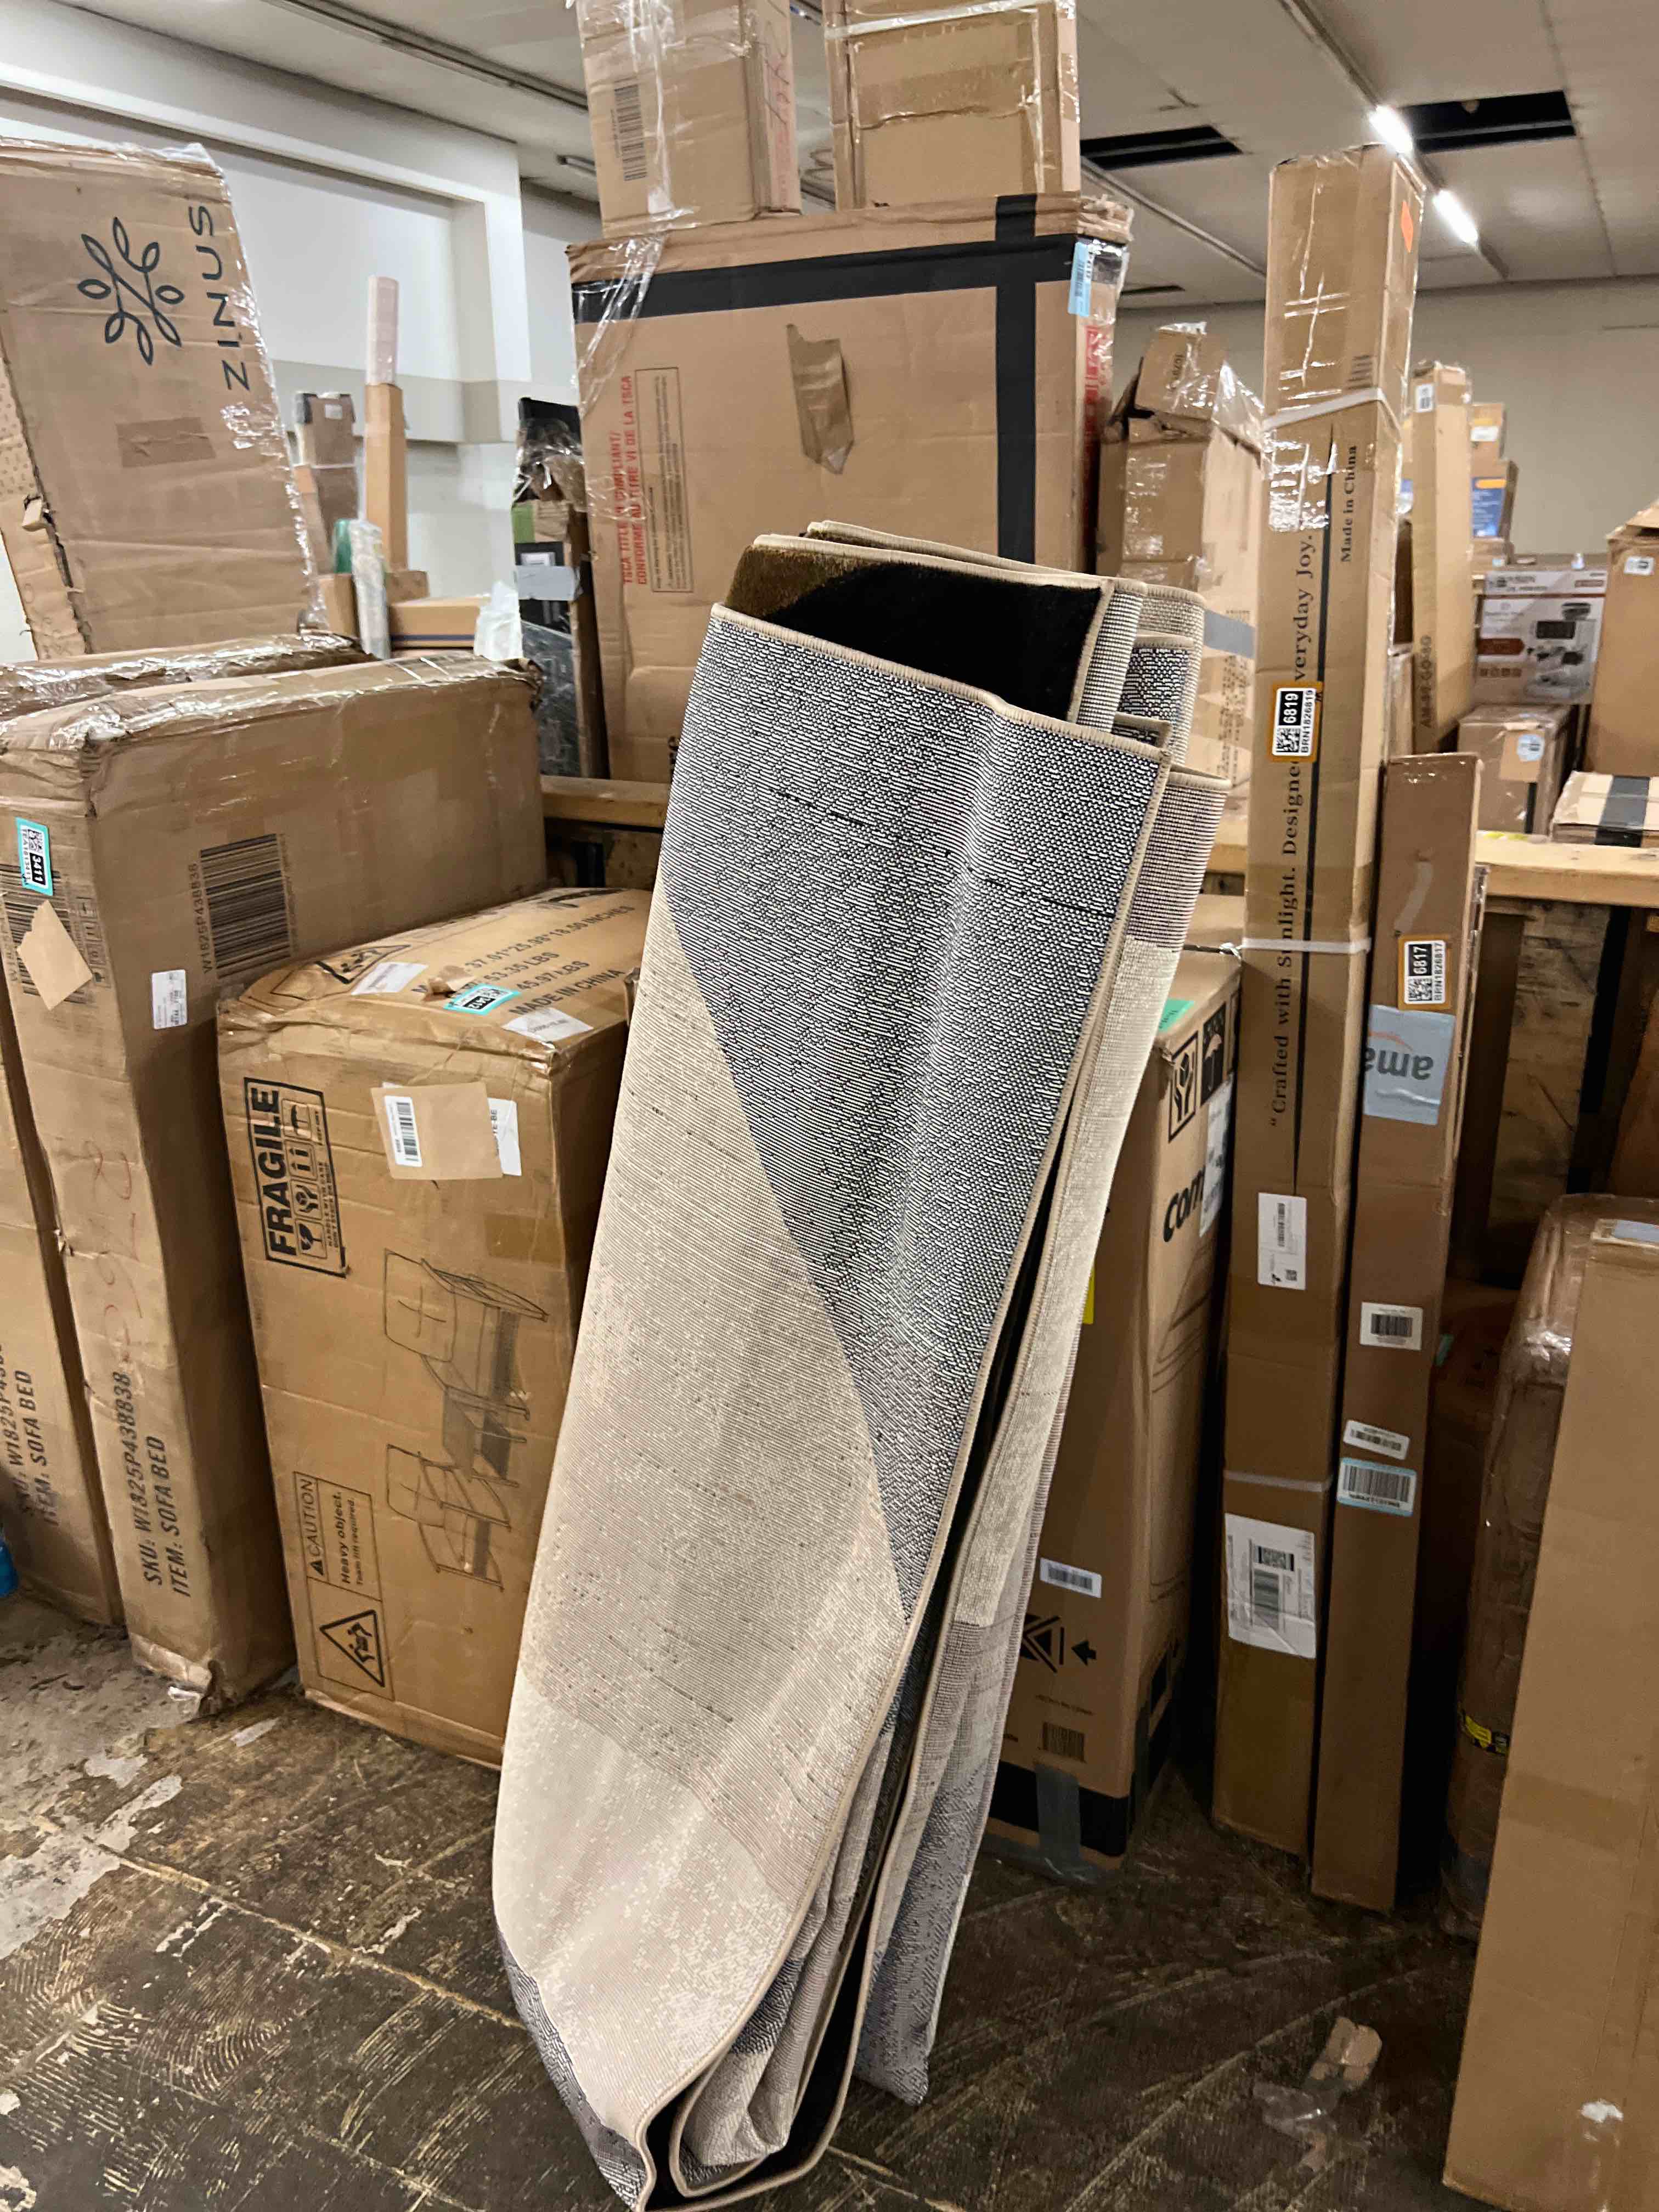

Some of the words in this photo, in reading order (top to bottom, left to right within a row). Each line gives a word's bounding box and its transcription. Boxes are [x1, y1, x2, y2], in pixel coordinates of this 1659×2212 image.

[188, 205, 251, 391] ZINUS
[623, 410, 634, 425] LA
[1344, 445, 1357, 495] China
[1342, 499, 1354, 514] in
[1295, 535, 1316, 579] Joy.
[1340, 518, 1353, 562] Made
[621, 556, 633, 584] TSCA
[1293, 587, 1313, 682] veryday
[1283, 693, 1299, 724] 6819
[1301, 690, 1313, 753] BRN1826819
[32, 855, 43, 882] 3411
[523, 951, 560, 966] LBS
[557, 960, 590, 976] LBS
[1412, 946, 1427, 974] 6817
[509, 993, 563, 1015] MADE
[555, 986, 576, 997] IN
[575, 969, 626, 990] CHINA
[1274, 977, 1291, 1026] with
[250, 1087, 297, 1256] FRAGILE
[14, 1370, 36, 1412] BED
[22, 1417, 47, 1466] SOFA
[112, 1370, 152, 1532] W1825P438838
[145, 1435, 170, 1480] BED
[154, 1484, 180, 1537] SOFA
[300, 1479, 321, 1557] CAUTION
[331, 1492, 346, 1539] object.
[138, 1540, 162, 1586] SKU:
[166, 1542, 191, 1598] ITEM:
[337, 1540, 351, 1584] Heavy
